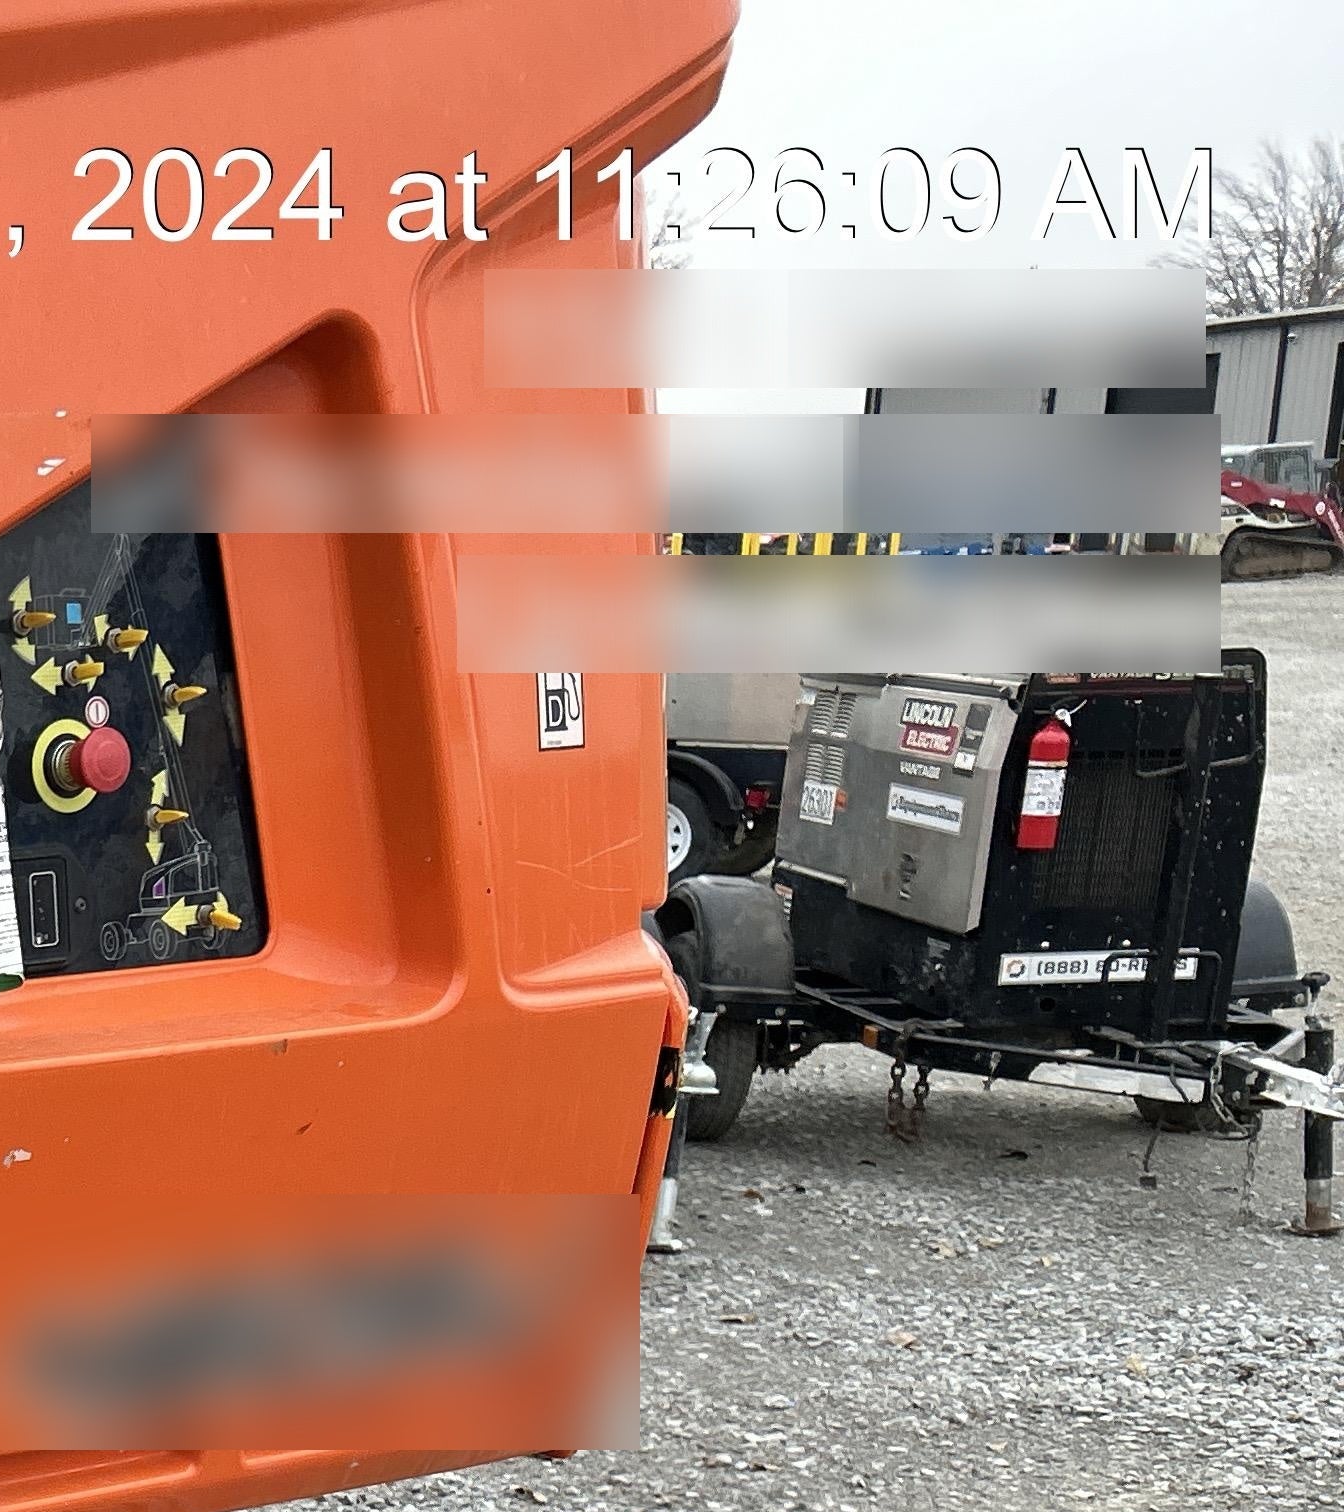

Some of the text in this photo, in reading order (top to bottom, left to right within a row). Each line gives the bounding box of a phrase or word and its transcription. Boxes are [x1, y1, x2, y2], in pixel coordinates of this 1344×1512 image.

[902, 700, 954, 728] LINCOLN
[907, 729, 952, 752] ELECTRIC
[1037, 960, 1088, 976] (888)
